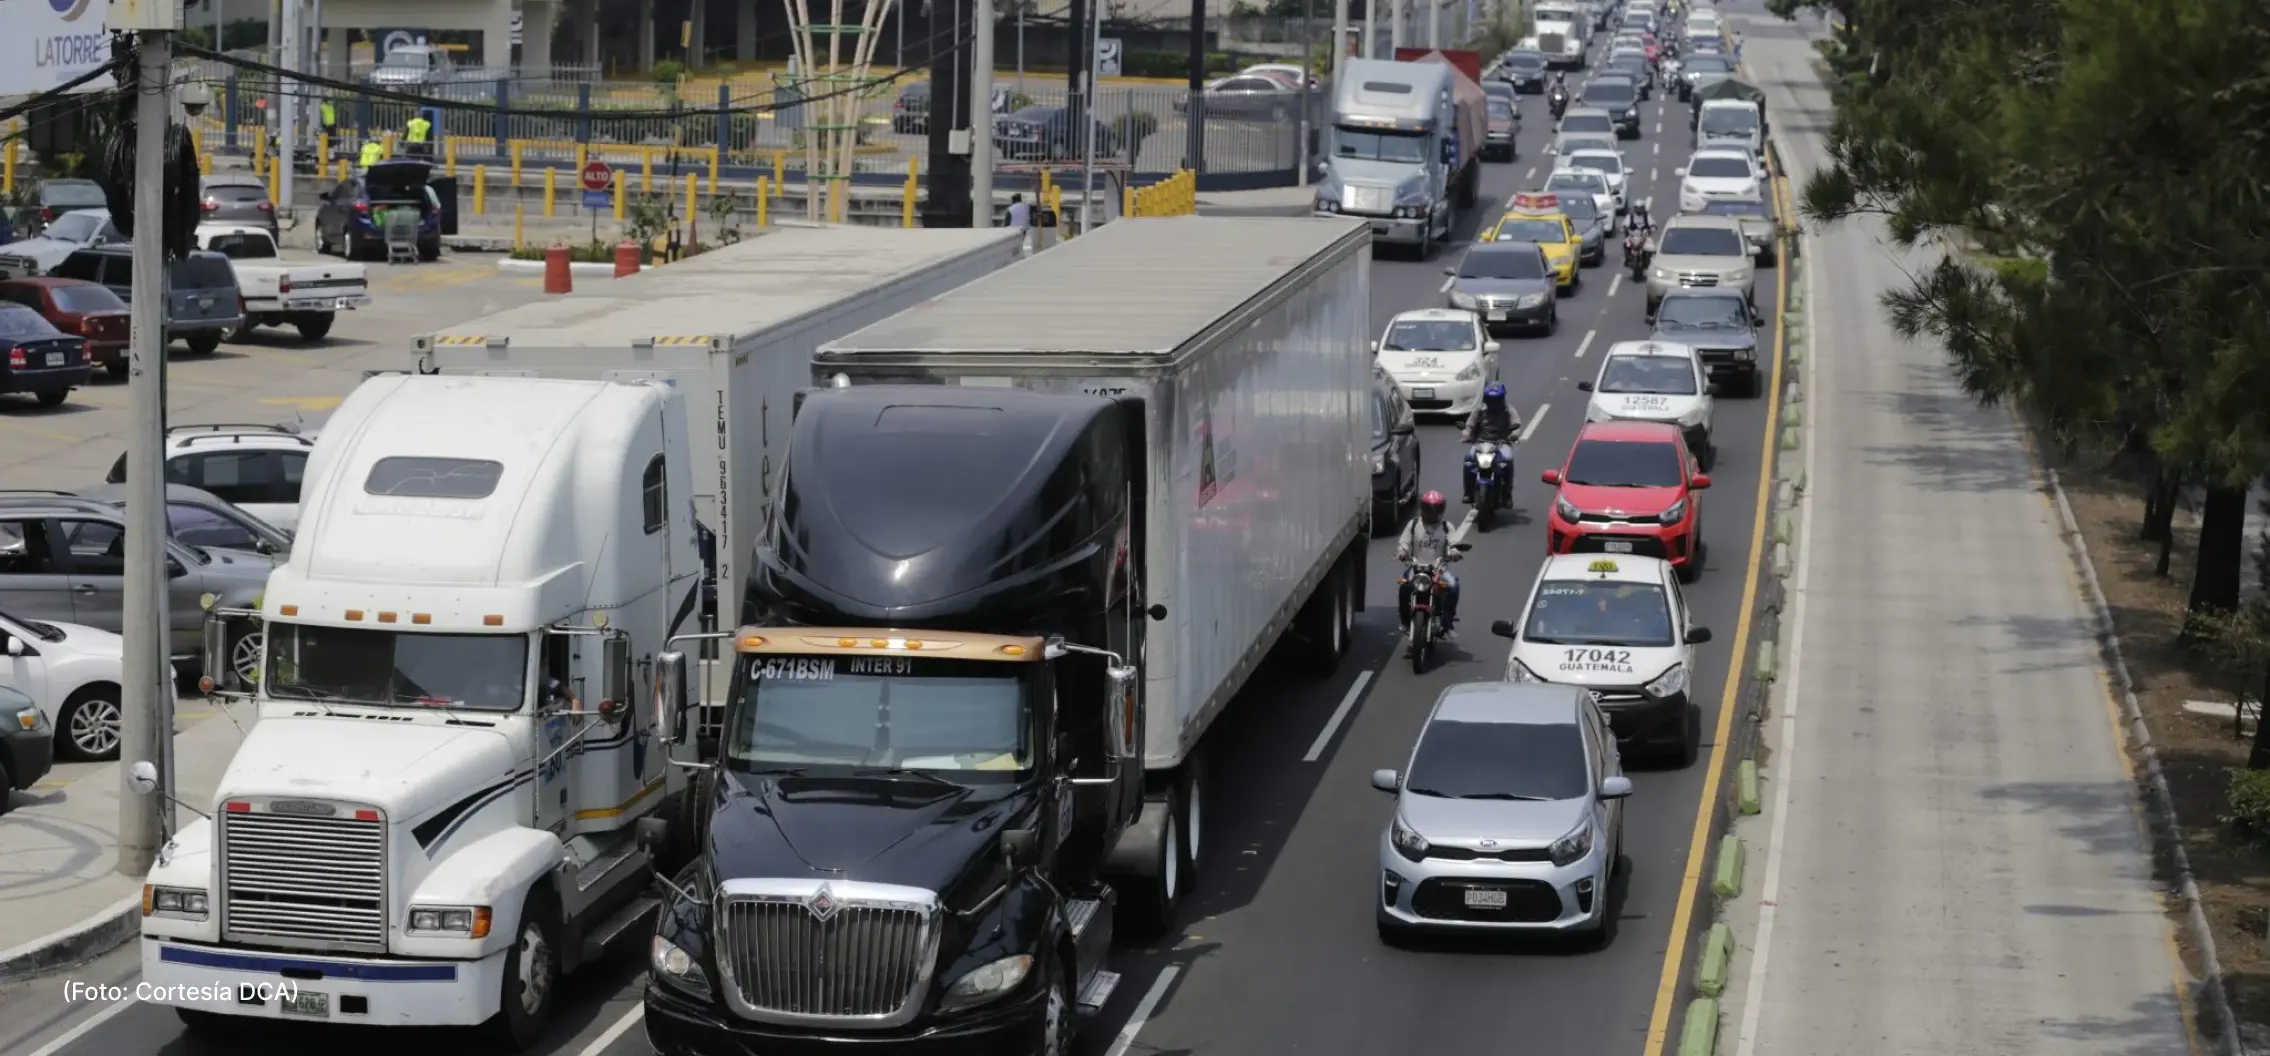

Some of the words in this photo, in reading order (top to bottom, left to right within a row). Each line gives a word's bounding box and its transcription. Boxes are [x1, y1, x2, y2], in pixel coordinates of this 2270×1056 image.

[584, 171, 609, 181] ALTO
[1623, 395, 1669, 405] 12587
[717, 390, 727, 450] TEMU
[719, 460, 729, 549] 963417
[722, 564, 729, 579] 2
[1564, 648, 1632, 664] 17042
[750, 657, 836, 680] C-671BSM
[851, 657, 892, 674] INTER
[896, 658, 912, 674] 91
[1559, 662, 1634, 673] GUATEMALA
